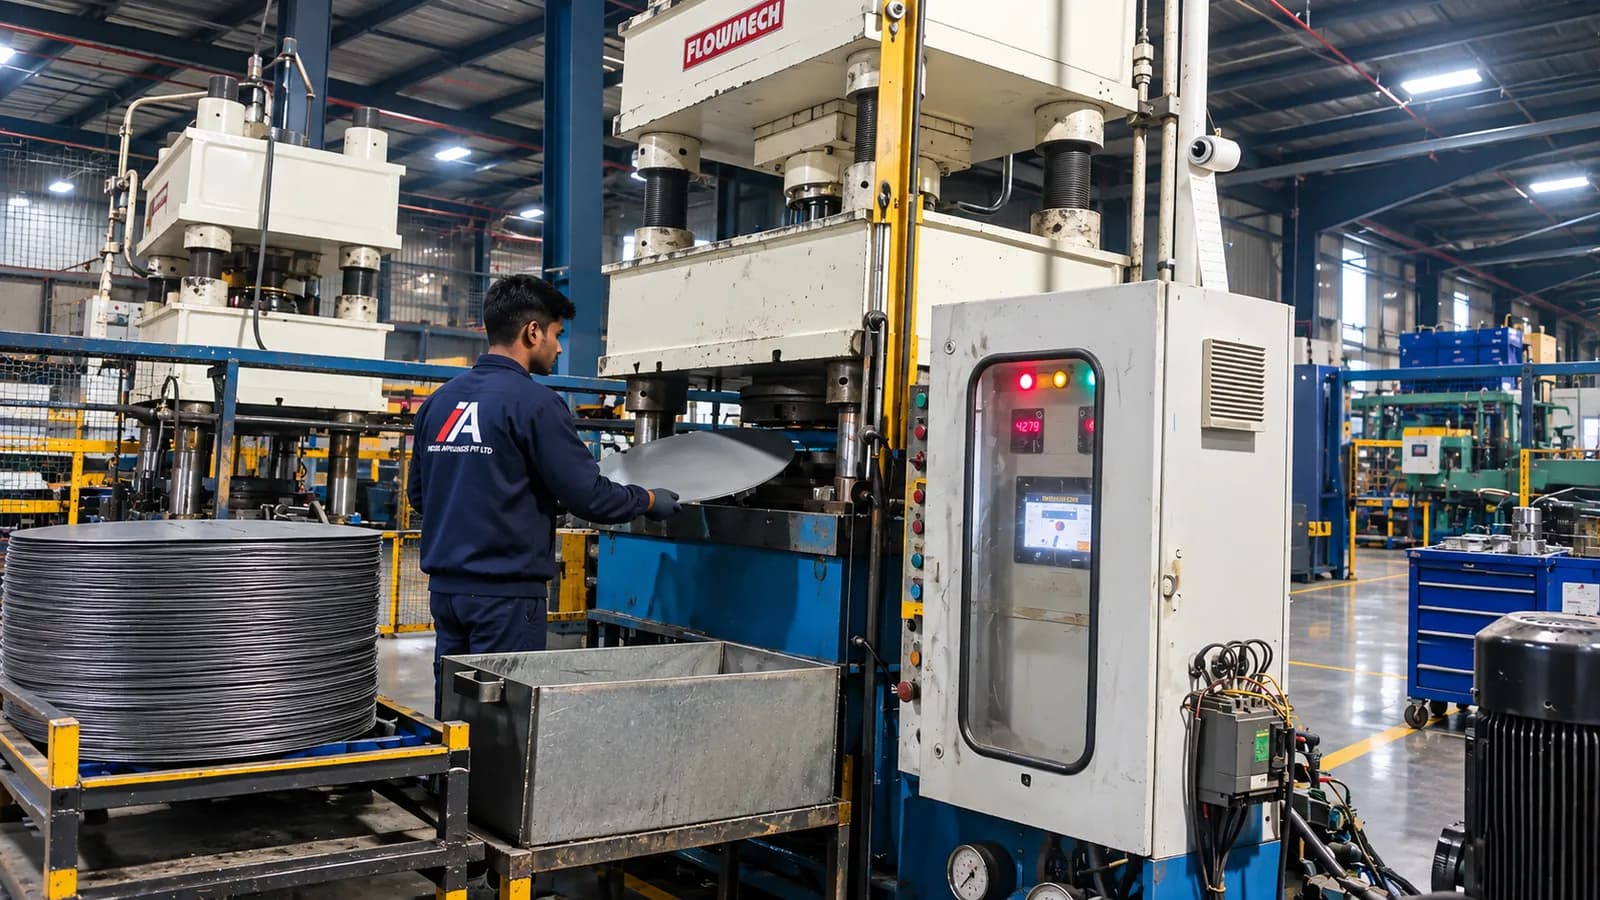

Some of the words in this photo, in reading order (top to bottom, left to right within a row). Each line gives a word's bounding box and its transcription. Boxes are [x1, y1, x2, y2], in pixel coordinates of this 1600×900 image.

[686, 1, 781, 64] FLOWMECH
[1016, 421, 1040, 432] 4279
[480, 446, 493, 454] LTD
